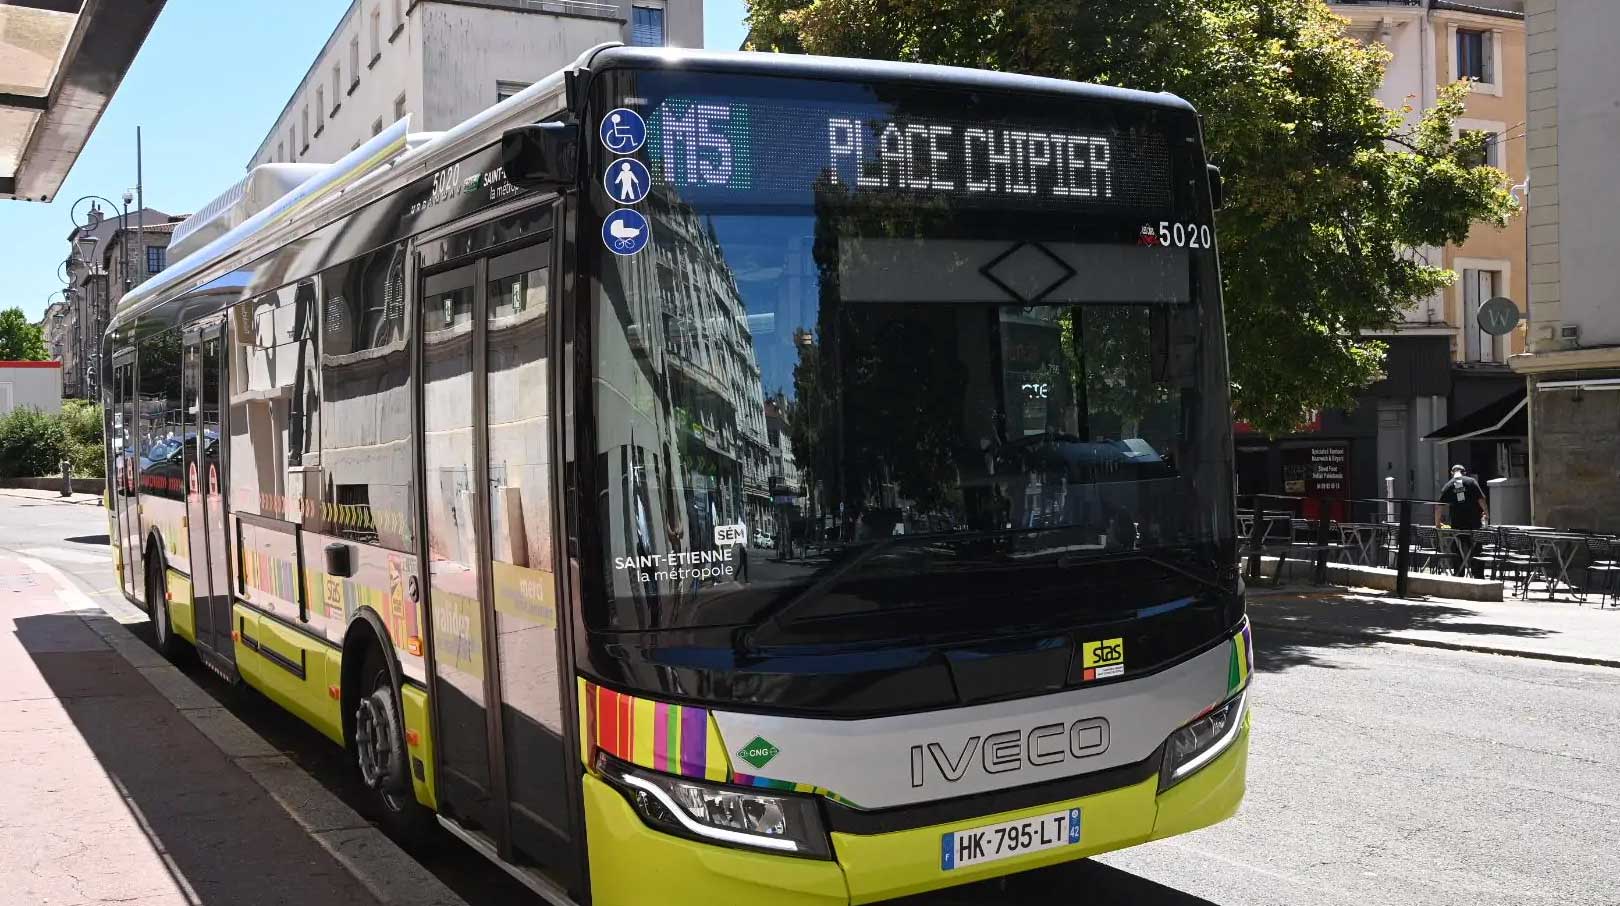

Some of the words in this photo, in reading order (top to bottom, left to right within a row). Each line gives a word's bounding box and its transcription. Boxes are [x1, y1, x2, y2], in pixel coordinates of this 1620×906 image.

[662, 102, 732, 183] M5
[829, 118, 954, 190] PLACE
[965, 128, 1112, 197] CHIPIER
[432, 163, 460, 196] 5020
[490, 186, 496, 200] la
[1159, 221, 1211, 249] 5020
[1488, 309, 1510, 327] W
[717, 526, 746, 540] SÉM
[615, 549, 733, 570] SAINT-ÉTIENNE
[637, 571, 650, 582] la
[654, 563, 734, 581] métropole
[1093, 640, 1121, 663] stas
[749, 748, 769, 757] CNG
[910, 717, 1111, 789] IVECO
[959, 817, 1066, 861] HK-795-LT
[1070, 826, 1079, 837] 42
[945, 853, 950, 861] F
